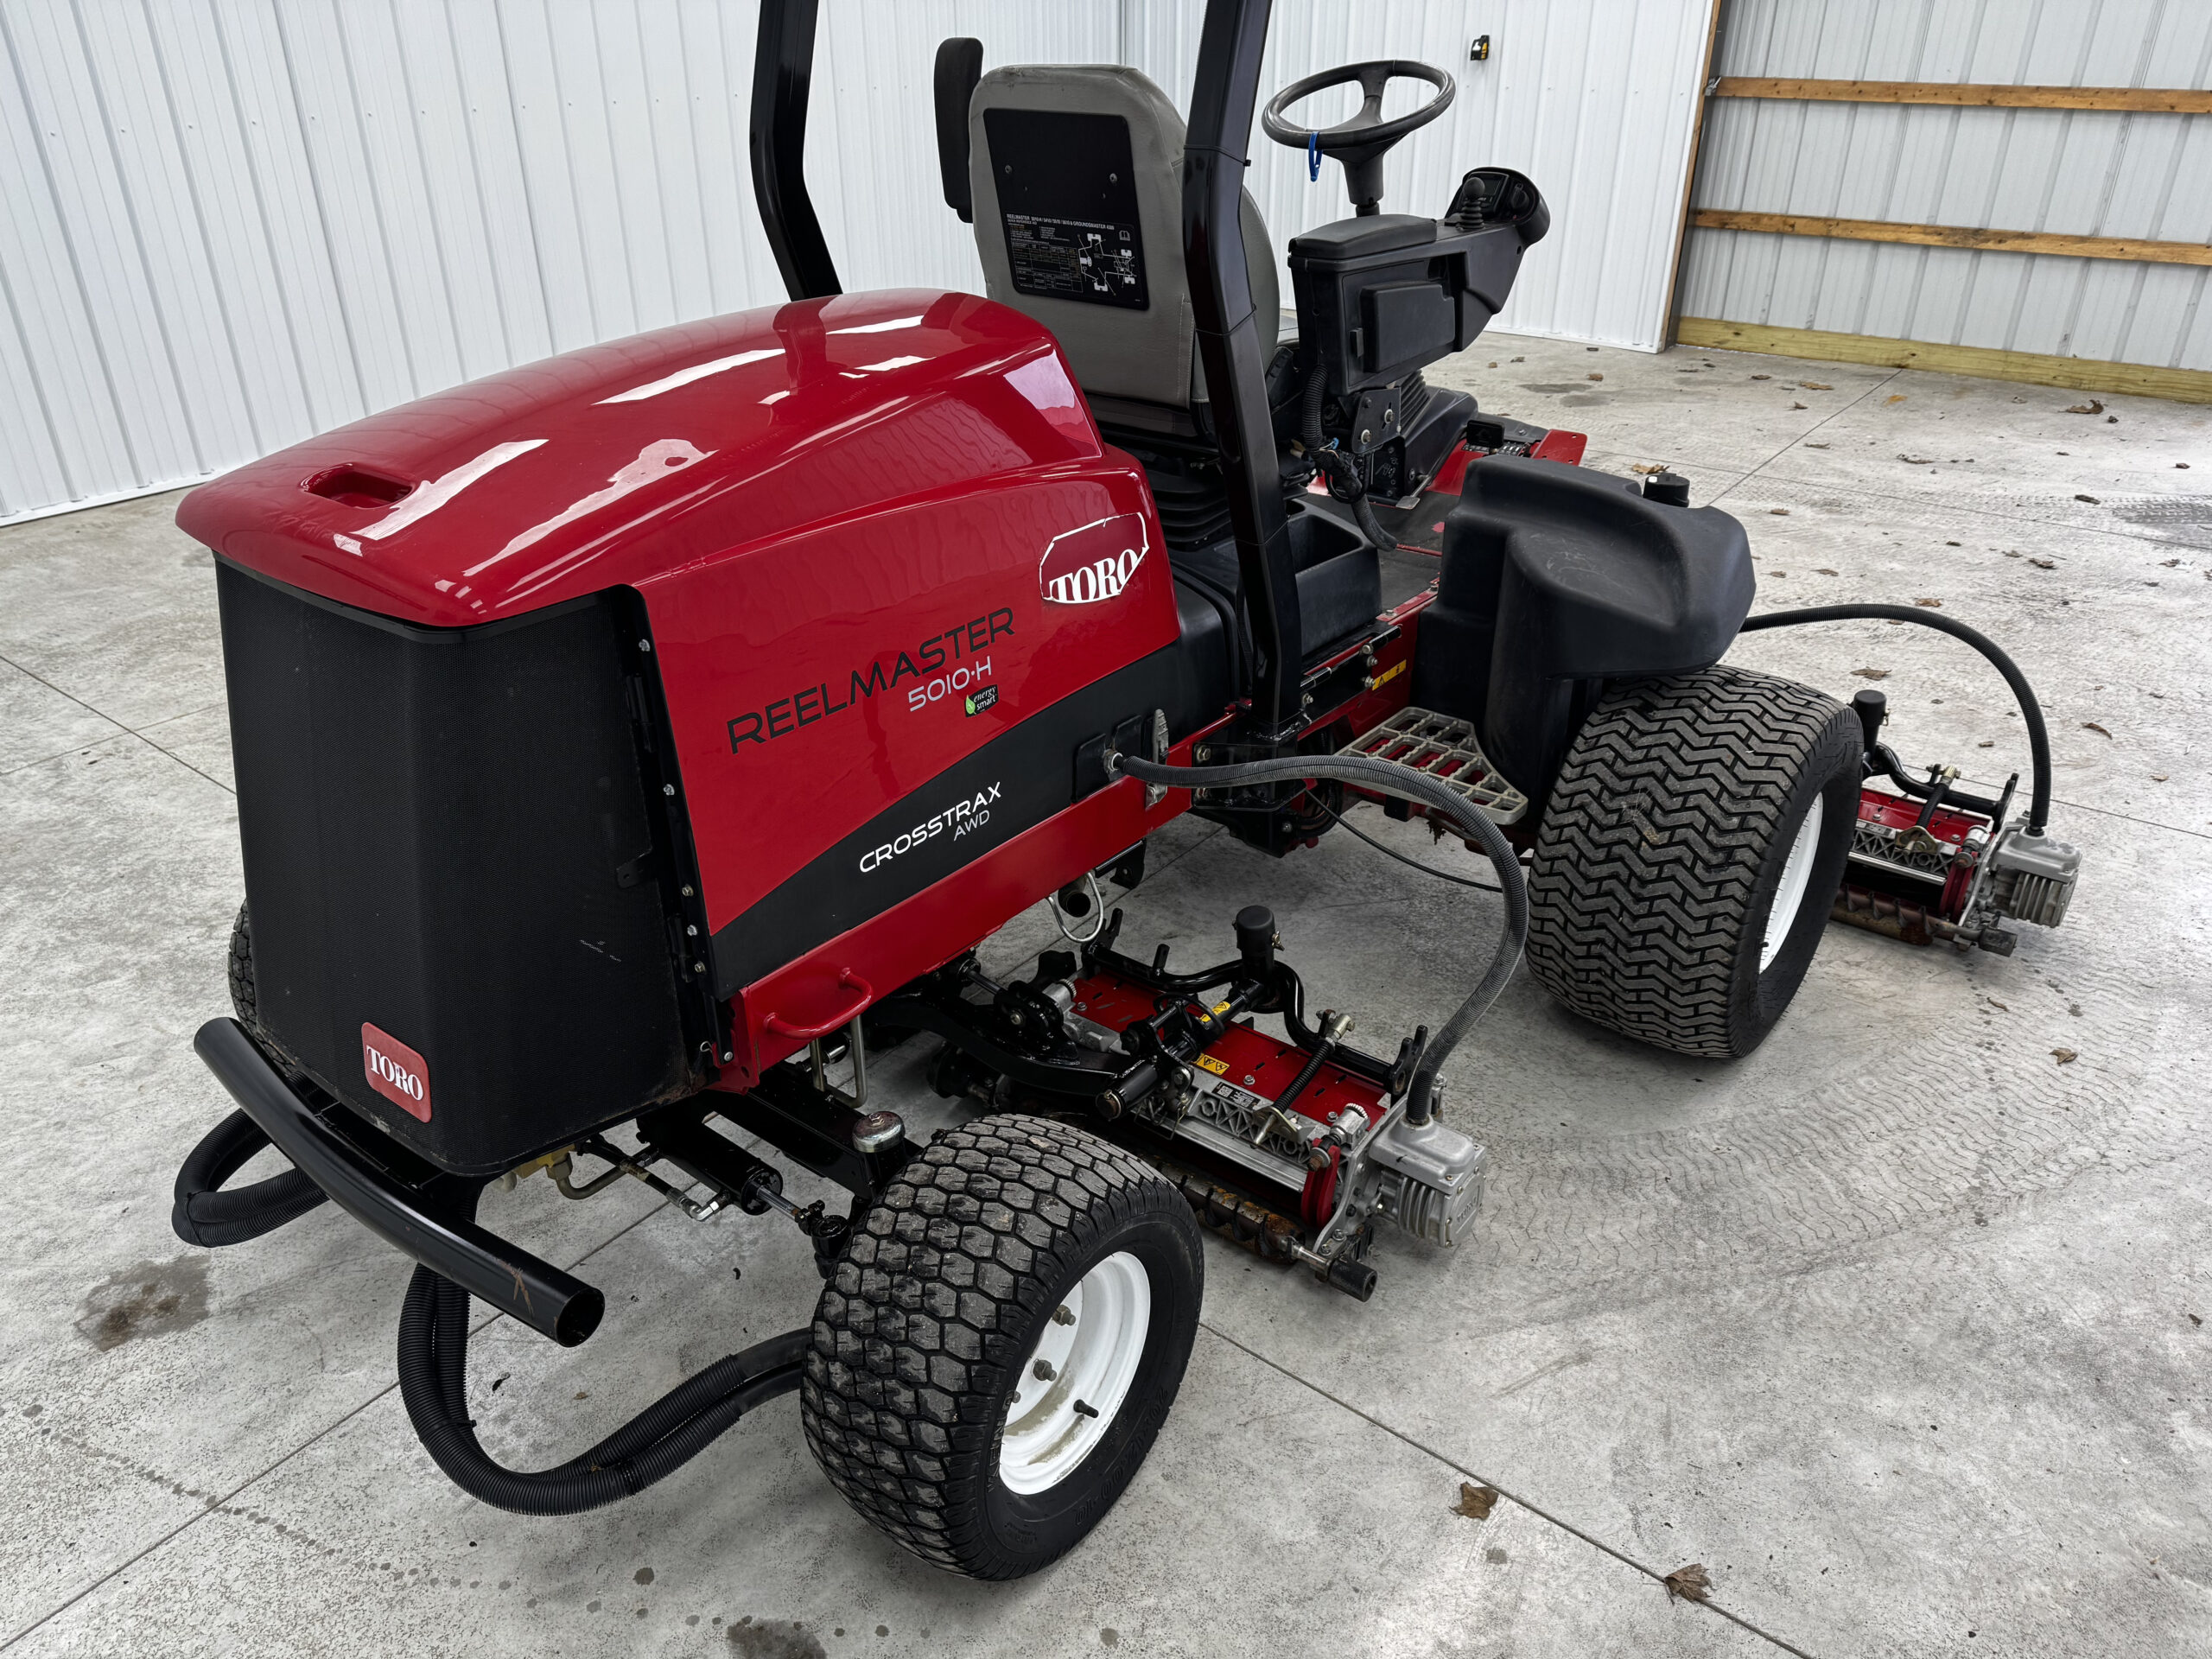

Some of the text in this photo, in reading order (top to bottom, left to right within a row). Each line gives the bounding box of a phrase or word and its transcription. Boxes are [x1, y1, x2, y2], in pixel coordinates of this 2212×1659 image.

[1049, 549, 1139, 603] TORO
[728, 607, 1014, 754] REELMASTER
[973, 686, 996, 703] energy
[976, 695, 996, 711] smart
[859, 781, 1002, 874] CROSSTRAX
[953, 810, 991, 842] AWD
[366, 1044, 424, 1101] TORO
